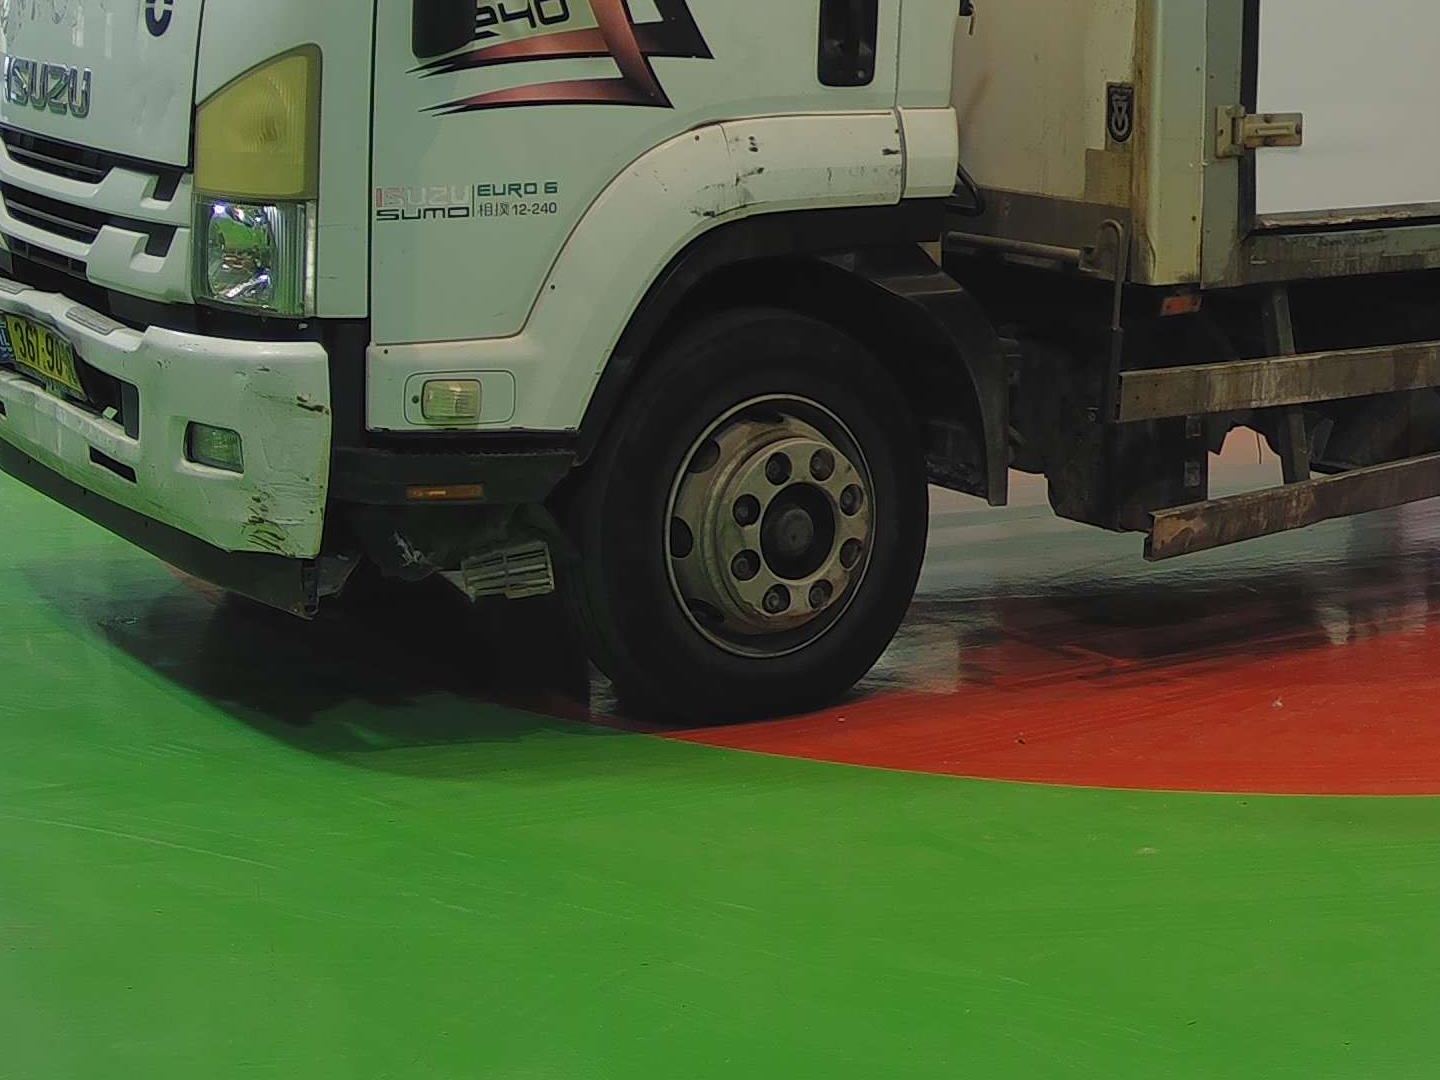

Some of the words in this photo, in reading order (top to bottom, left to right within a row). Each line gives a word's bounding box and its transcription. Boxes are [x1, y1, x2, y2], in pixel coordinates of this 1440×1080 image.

[3, 55, 92, 119] ISUZU
[477, 182, 538, 198] EURO
[544, 181, 558, 194] 6
[376, 206, 470, 221] SUMO
[511, 201, 558, 216] 12-240
